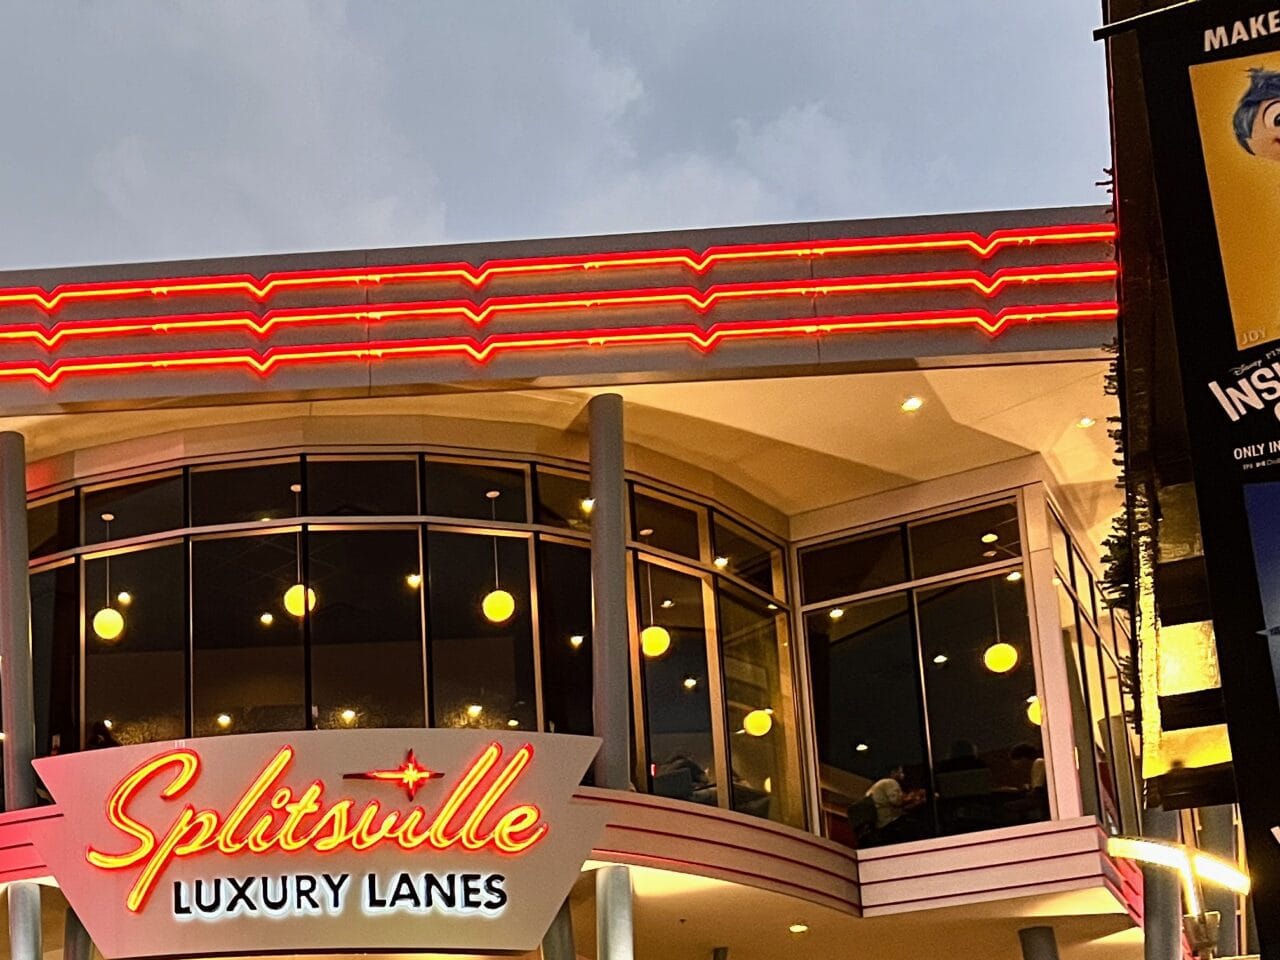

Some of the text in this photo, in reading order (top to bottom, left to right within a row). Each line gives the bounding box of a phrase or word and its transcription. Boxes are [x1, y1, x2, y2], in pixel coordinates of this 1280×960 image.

[1204, 9, 1280, 52] MAKE
[1233, 443, 1265, 460] ONLY
[86, 742, 549, 913] Splitsville
[173, 872, 507, 915] LUXURY LANES
